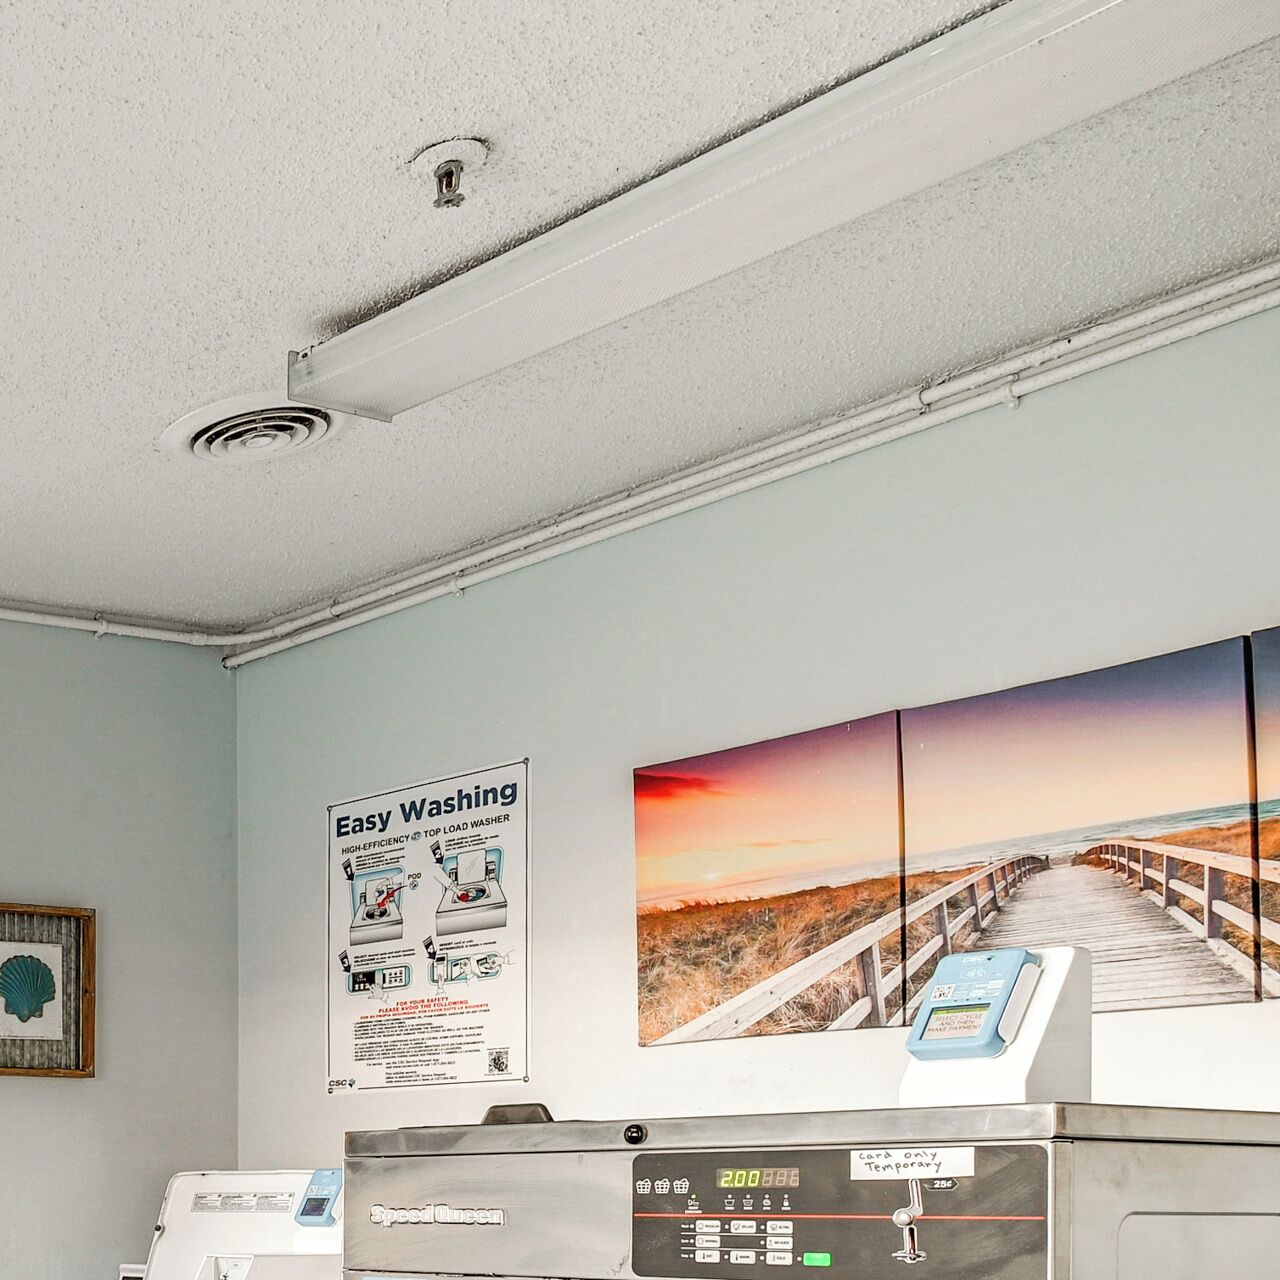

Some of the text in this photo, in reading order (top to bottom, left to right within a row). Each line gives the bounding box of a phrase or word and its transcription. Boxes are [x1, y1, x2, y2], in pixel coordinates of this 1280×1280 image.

[336, 782, 518, 838] Easy Washing
[341, 834, 410, 855] HIGH-EFFICIENCY
[424, 828, 441, 838] TOP
[443, 822, 468, 834] LOAD
[471, 813, 510, 829] WASHER
[407, 872, 422, 881] POD
[864, 1161, 942, 1174] Temporary
[934, 1180, 952, 1188] 25¢
[370, 1203, 505, 1228] Speed Queen
